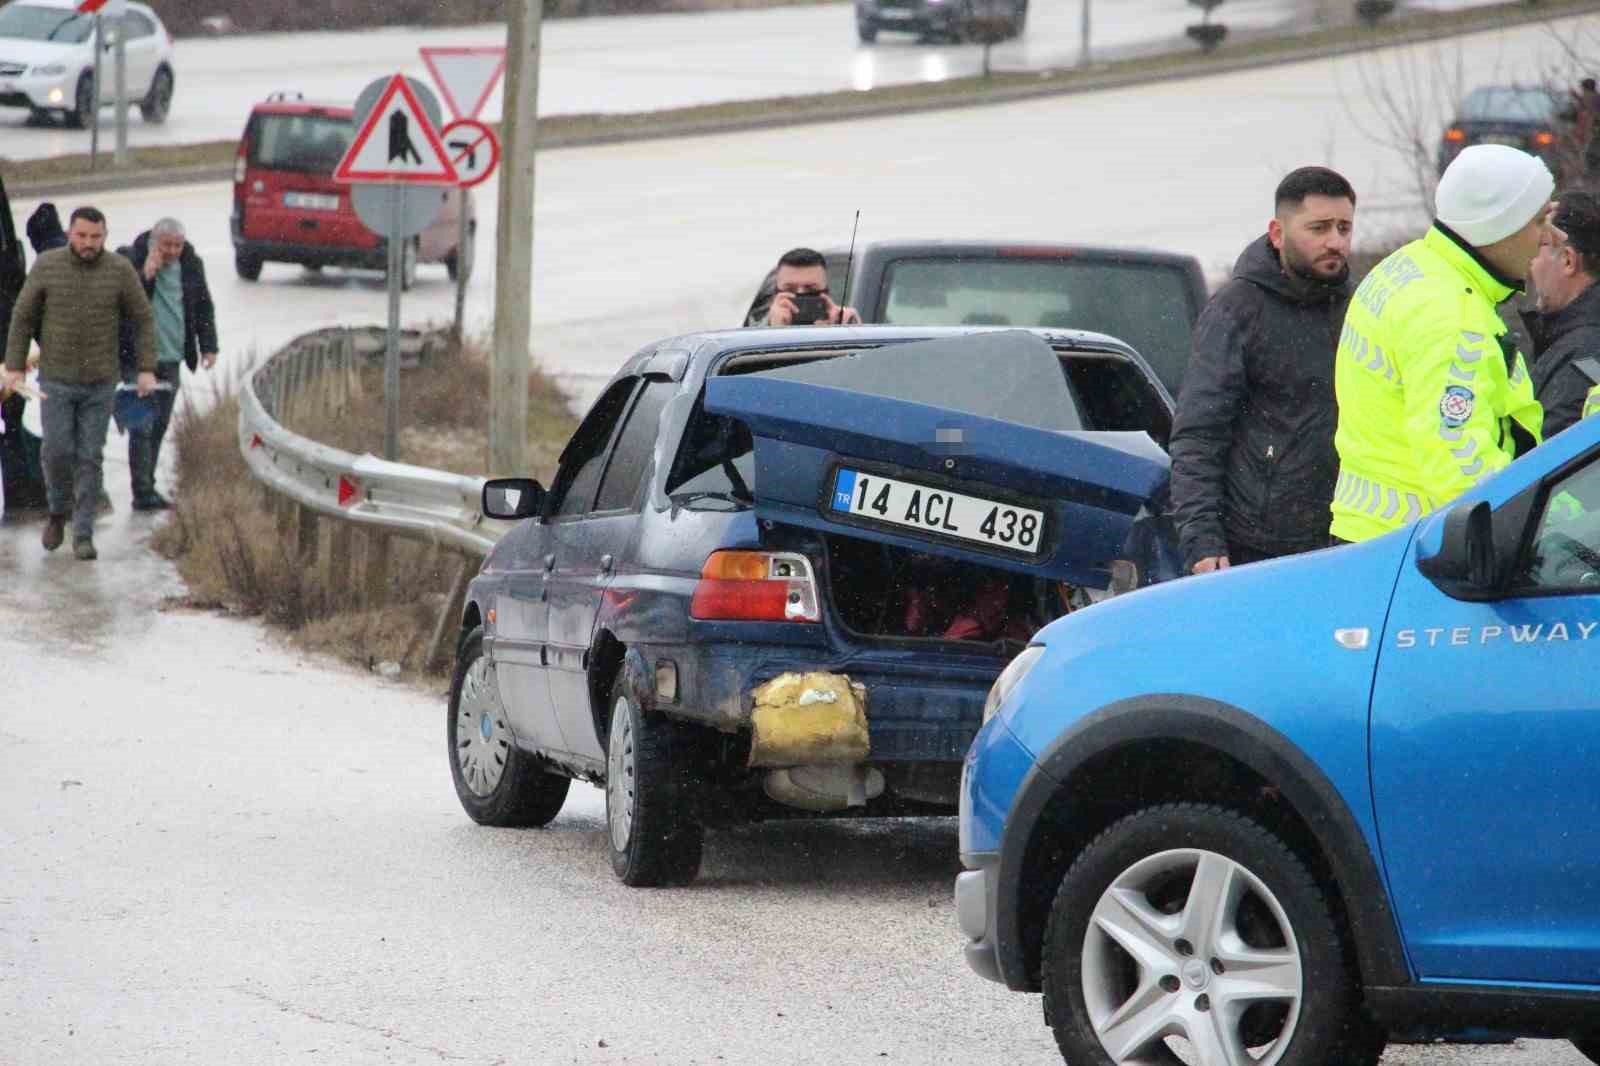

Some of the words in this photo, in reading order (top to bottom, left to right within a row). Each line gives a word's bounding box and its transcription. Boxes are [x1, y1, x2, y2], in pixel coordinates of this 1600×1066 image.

[837, 492, 850, 505] TR
[857, 478, 891, 515] 14
[904, 489, 958, 532] ACL
[979, 506, 1038, 546] 438
[1396, 622, 1598, 648] STEPWAY
